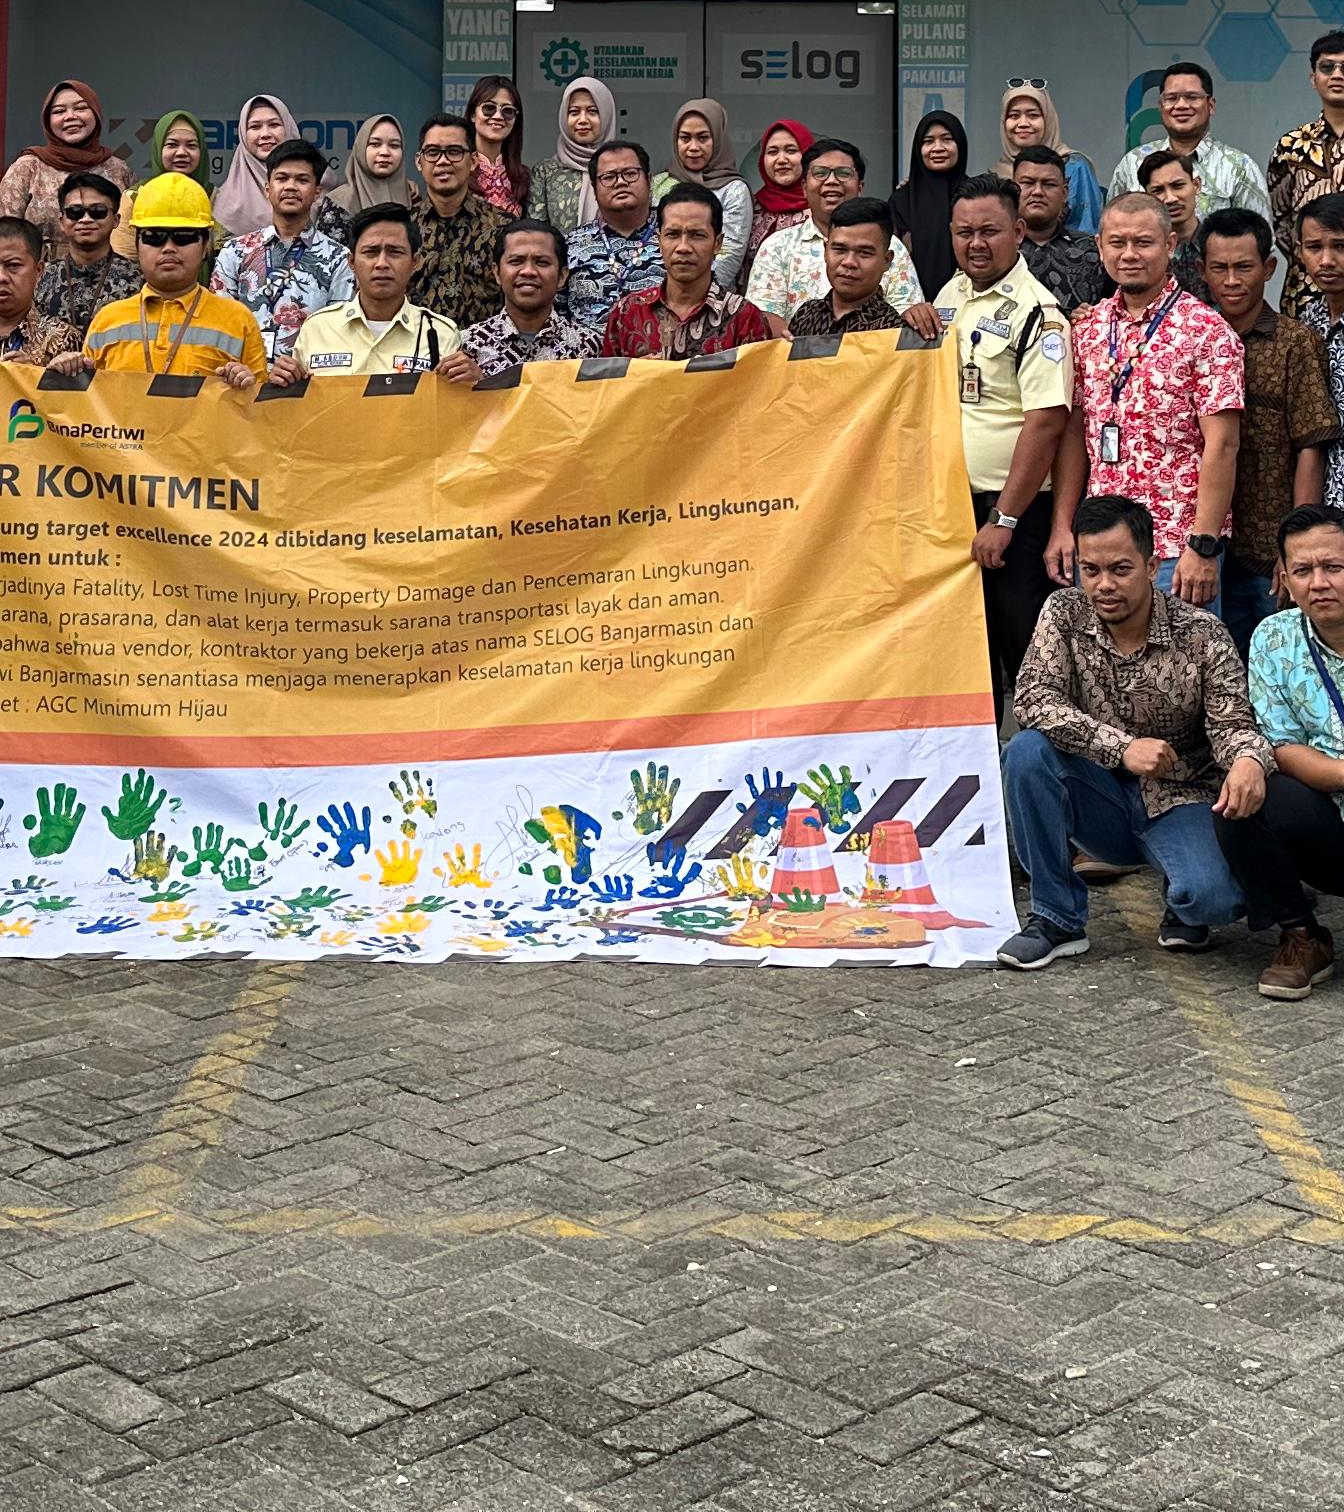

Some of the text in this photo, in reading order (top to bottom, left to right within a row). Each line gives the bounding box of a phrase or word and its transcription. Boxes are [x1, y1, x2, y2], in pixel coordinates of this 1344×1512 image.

[902, 4, 966, 18] SELAMAT!
[447, 9, 511, 36] YANG
[902, 23, 966, 39] PULANG
[446, 41, 509, 62] UTAMA
[594, 45, 644, 55] UTAMAKAN
[902, 45, 966, 59] SELAMAT!
[594, 57, 678, 67] KESELAMATAN DAN
[594, 68, 674, 78] KESEHATAN KERJA
[902, 70, 965, 84] PAKAILAH
[37, 464, 259, 511] KOMITMEN
[46, 520, 109, 540] target
[115, 524, 213, 547] excellence
[218, 531, 269, 547] 2024
[275, 529, 367, 550] dibidang
[374, 524, 504, 546] keselamatan,
[510, 514, 611, 537] Kesehatan
[618, 504, 672, 527] Kerja,
[679, 496, 800, 522] Lingkungan,
[48, 549, 109, 566] untuk
[73, 578, 145, 601] Fatality,
[153, 580, 189, 598] Lost
[193, 584, 238, 603] Time
[245, 587, 301, 609] Injury,
[308, 586, 390, 609] Property
[397, 584, 475, 603] Damage
[482, 578, 517, 596] dan
[523, 567, 635, 592] Pencemaran
[642, 558, 755, 582] Lingkungan.
[59, 610, 158, 631] prasarana,
[165, 609, 201, 627] dan
[207, 613, 239, 630] alat
[245, 614, 289, 637] kerja
[295, 613, 383, 633] termasuk
[389, 615, 451, 631] sarana
[457, 601, 569, 625] transportasi
[575, 595, 622, 619] layak
[628, 593, 662, 610] dan
[668, 589, 724, 607] aman.
[55, 640, 116, 656] semua
[123, 639, 193, 659] vendor,
[200, 639, 297, 660] kontraktor
[303, 646, 349, 664] yang
[356, 640, 425, 661] bekerja
[431, 639, 469, 655] atas
[475, 634, 527, 651] nama
[533, 626, 594, 647] SELOG
[601, 617, 713, 644] Banjarmasin
[719, 615, 754, 633] dan
[20, 665, 130, 687] Banjarmasin
[136, 668, 239, 688] senantiasa
[246, 670, 327, 692] menjaga
[334, 666, 451, 689] menerapkan
[458, 659, 573, 681] keselamatan
[580, 653, 624, 675] kerja
[630, 647, 735, 672] lingkungan
[36, 696, 78, 714] AGC
[84, 696, 171, 717] Minimum
[178, 700, 228, 721] Hijau
